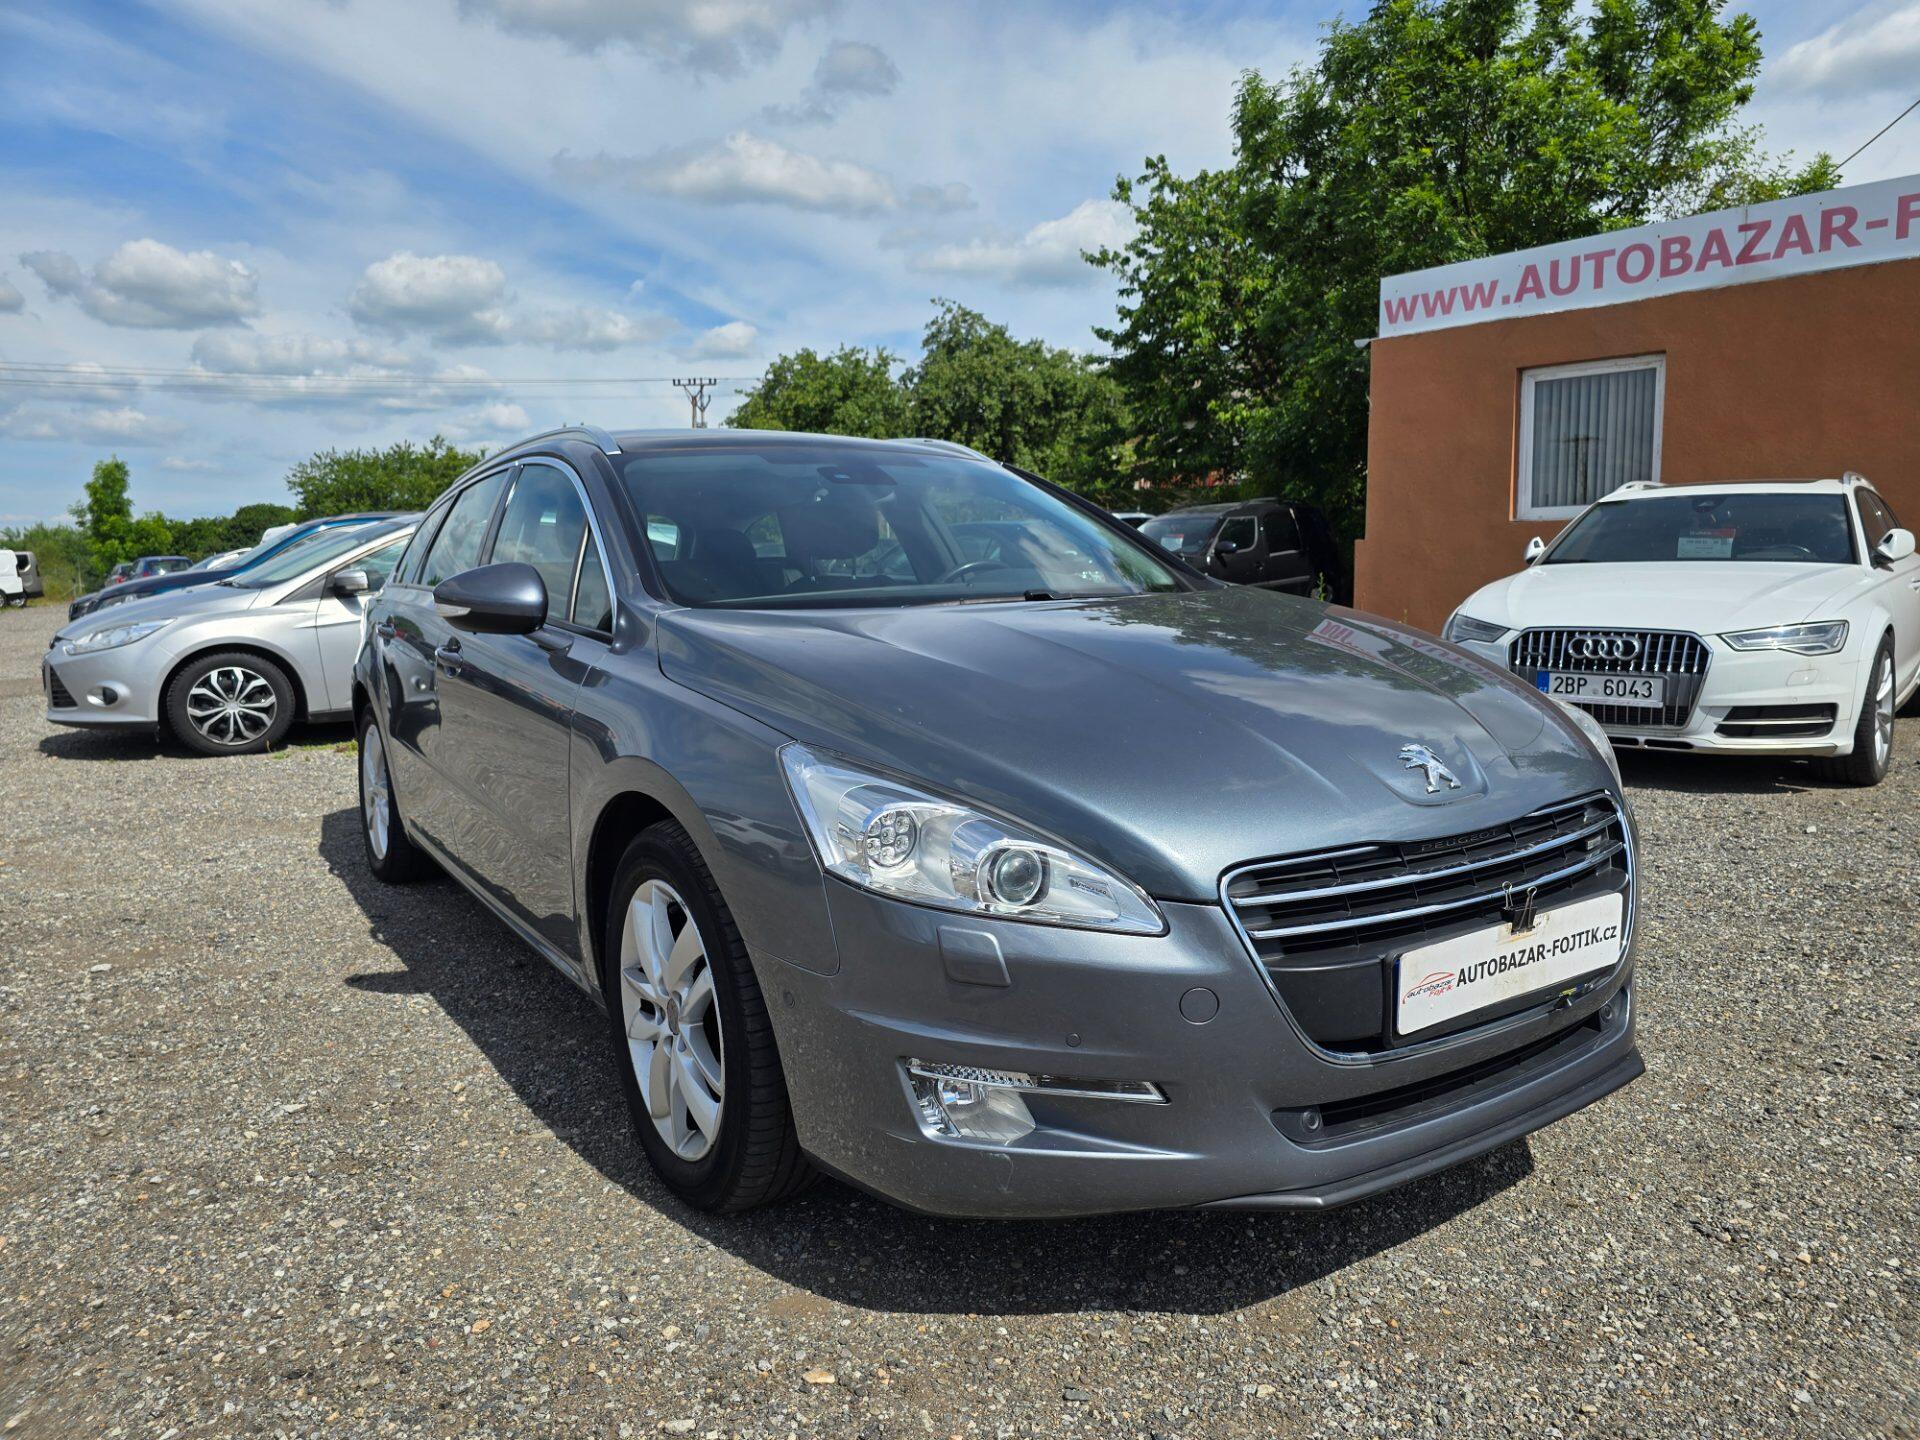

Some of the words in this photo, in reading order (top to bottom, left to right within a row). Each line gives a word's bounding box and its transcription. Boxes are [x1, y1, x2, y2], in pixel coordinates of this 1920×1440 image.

[1553, 676, 1588, 695] 2BP
[1603, 679, 1653, 698] 6043
[1456, 924, 1618, 987] AUTOBAZAR-FOJTIK.cz
